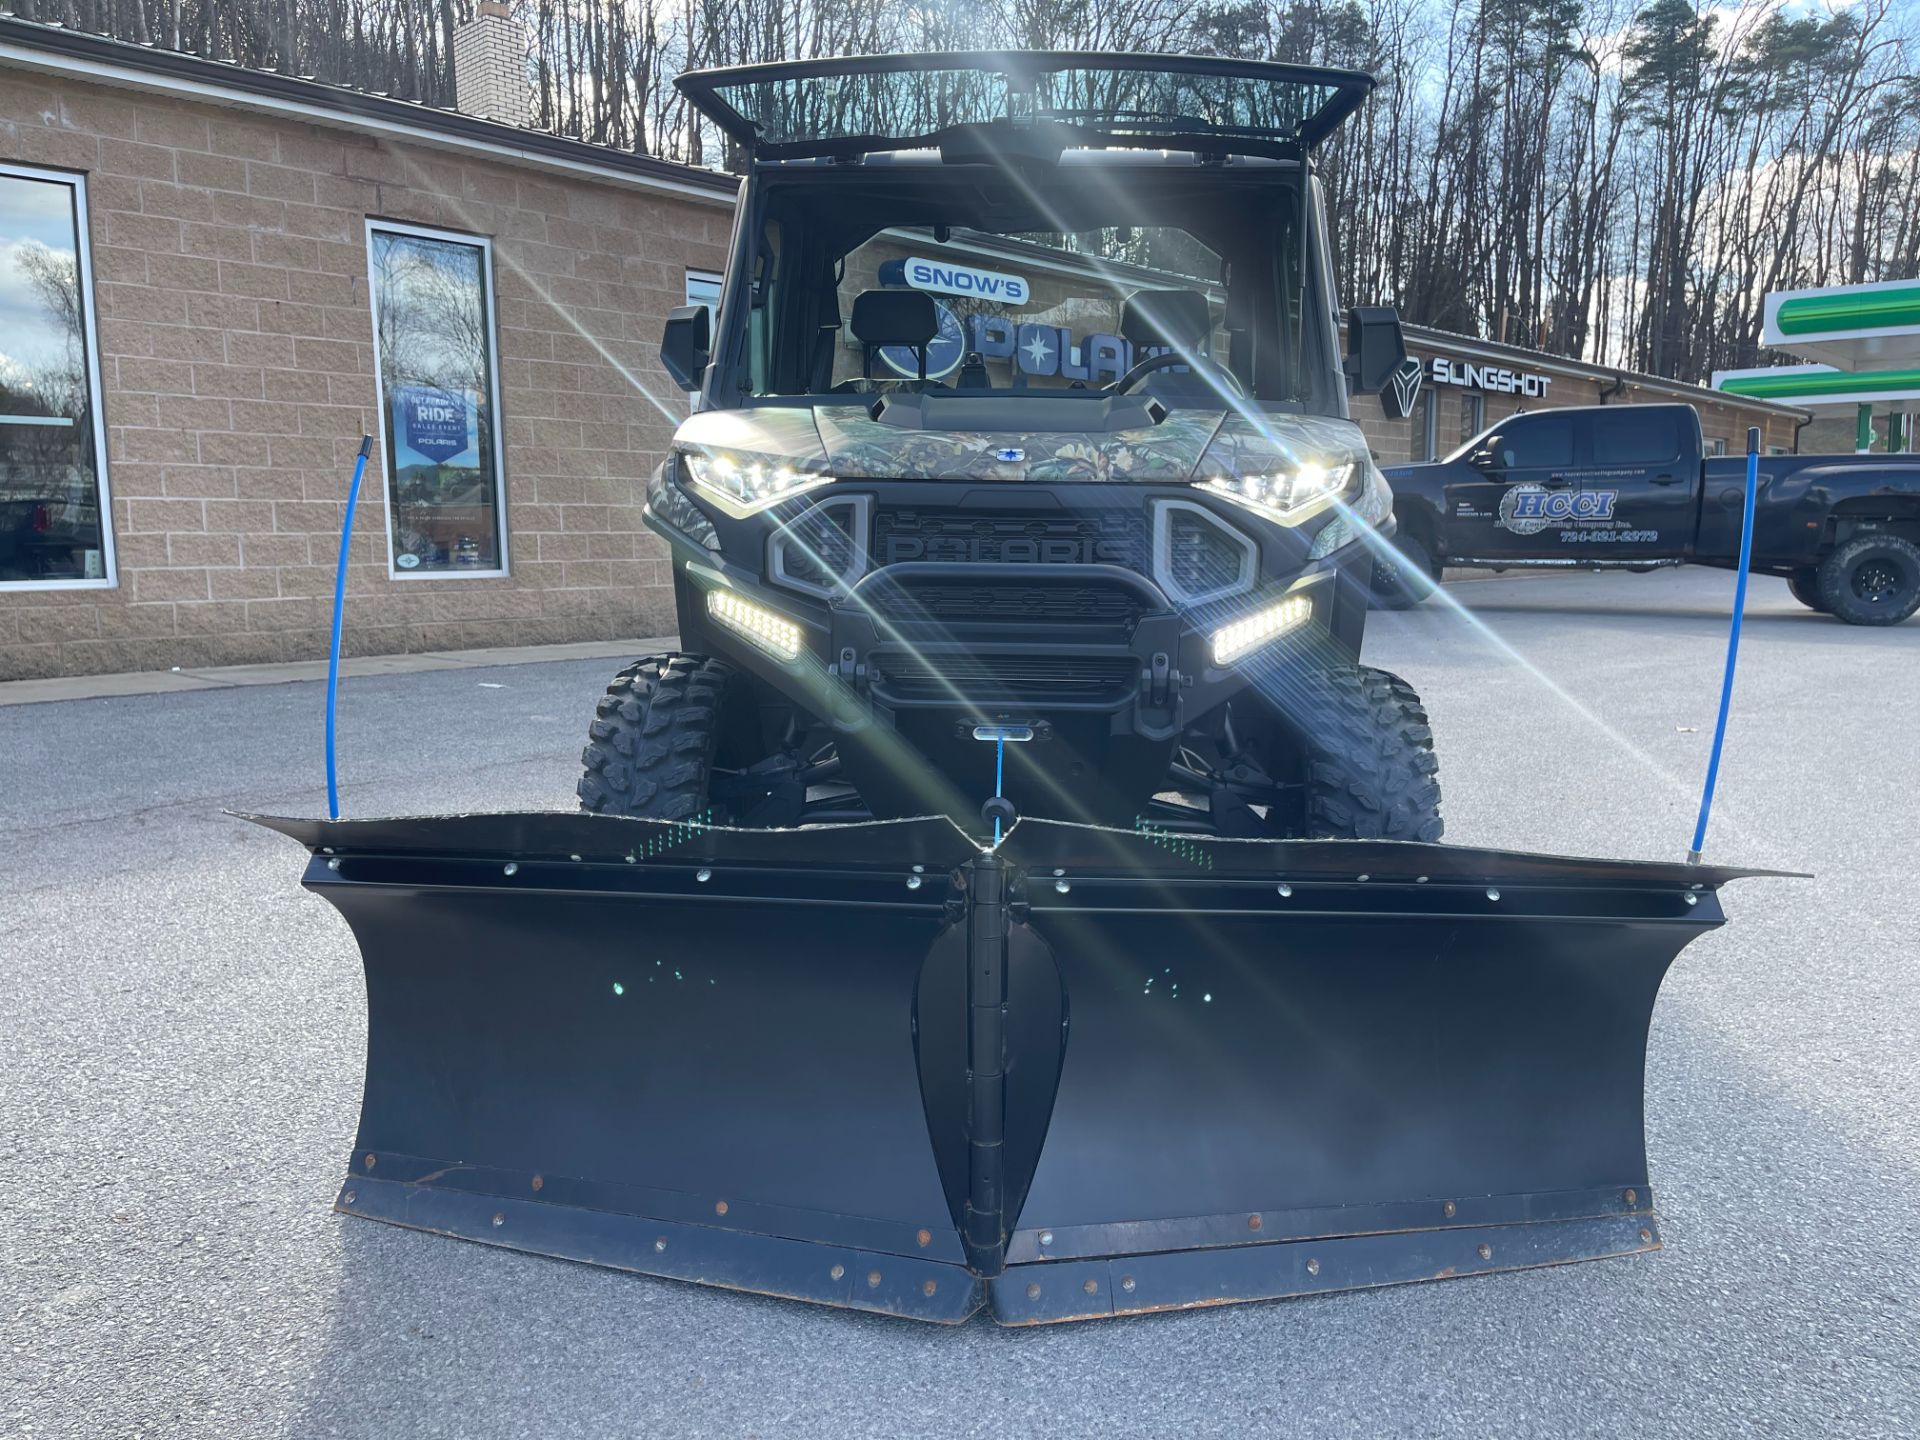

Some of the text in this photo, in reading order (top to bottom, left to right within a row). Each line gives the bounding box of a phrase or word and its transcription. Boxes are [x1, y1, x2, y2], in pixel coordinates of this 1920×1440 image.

[913, 265, 1022, 298] SNOW'S
[969, 315, 1191, 382] POLA
[1432, 357, 1552, 398] SLINGSHOT
[417, 406, 455, 423] RIDE
[418, 438, 457, 446] POLARIS
[1512, 490, 1618, 520] HCCI
